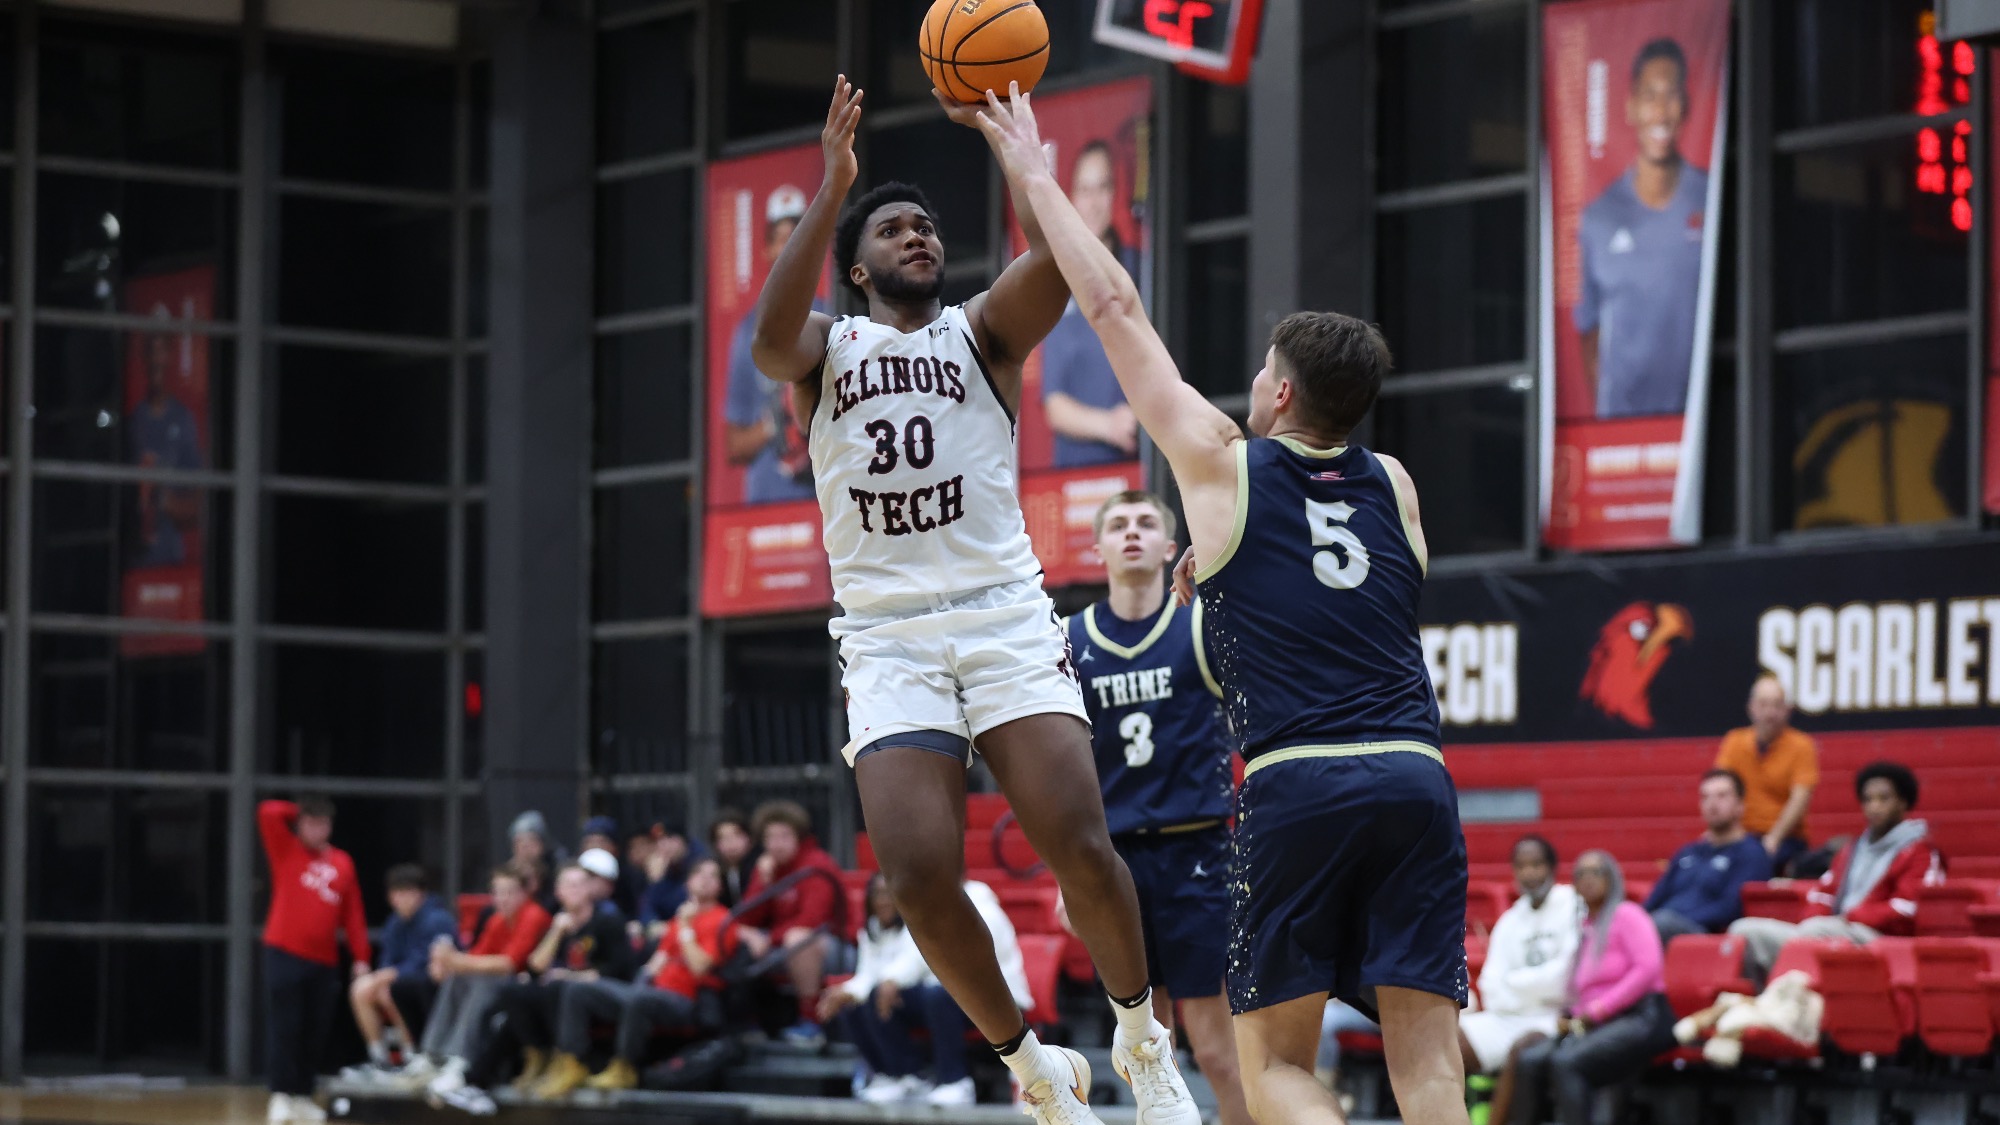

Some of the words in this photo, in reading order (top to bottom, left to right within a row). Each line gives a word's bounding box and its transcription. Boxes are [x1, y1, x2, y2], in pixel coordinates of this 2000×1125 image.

[832, 356, 966, 422] ILLINOIS
[864, 415, 936, 476] 30
[849, 474, 965, 536] TECH
[1305, 497, 1371, 590] 5
[1091, 666, 1173, 709] TRINE
[1118, 711, 1155, 768] 3
